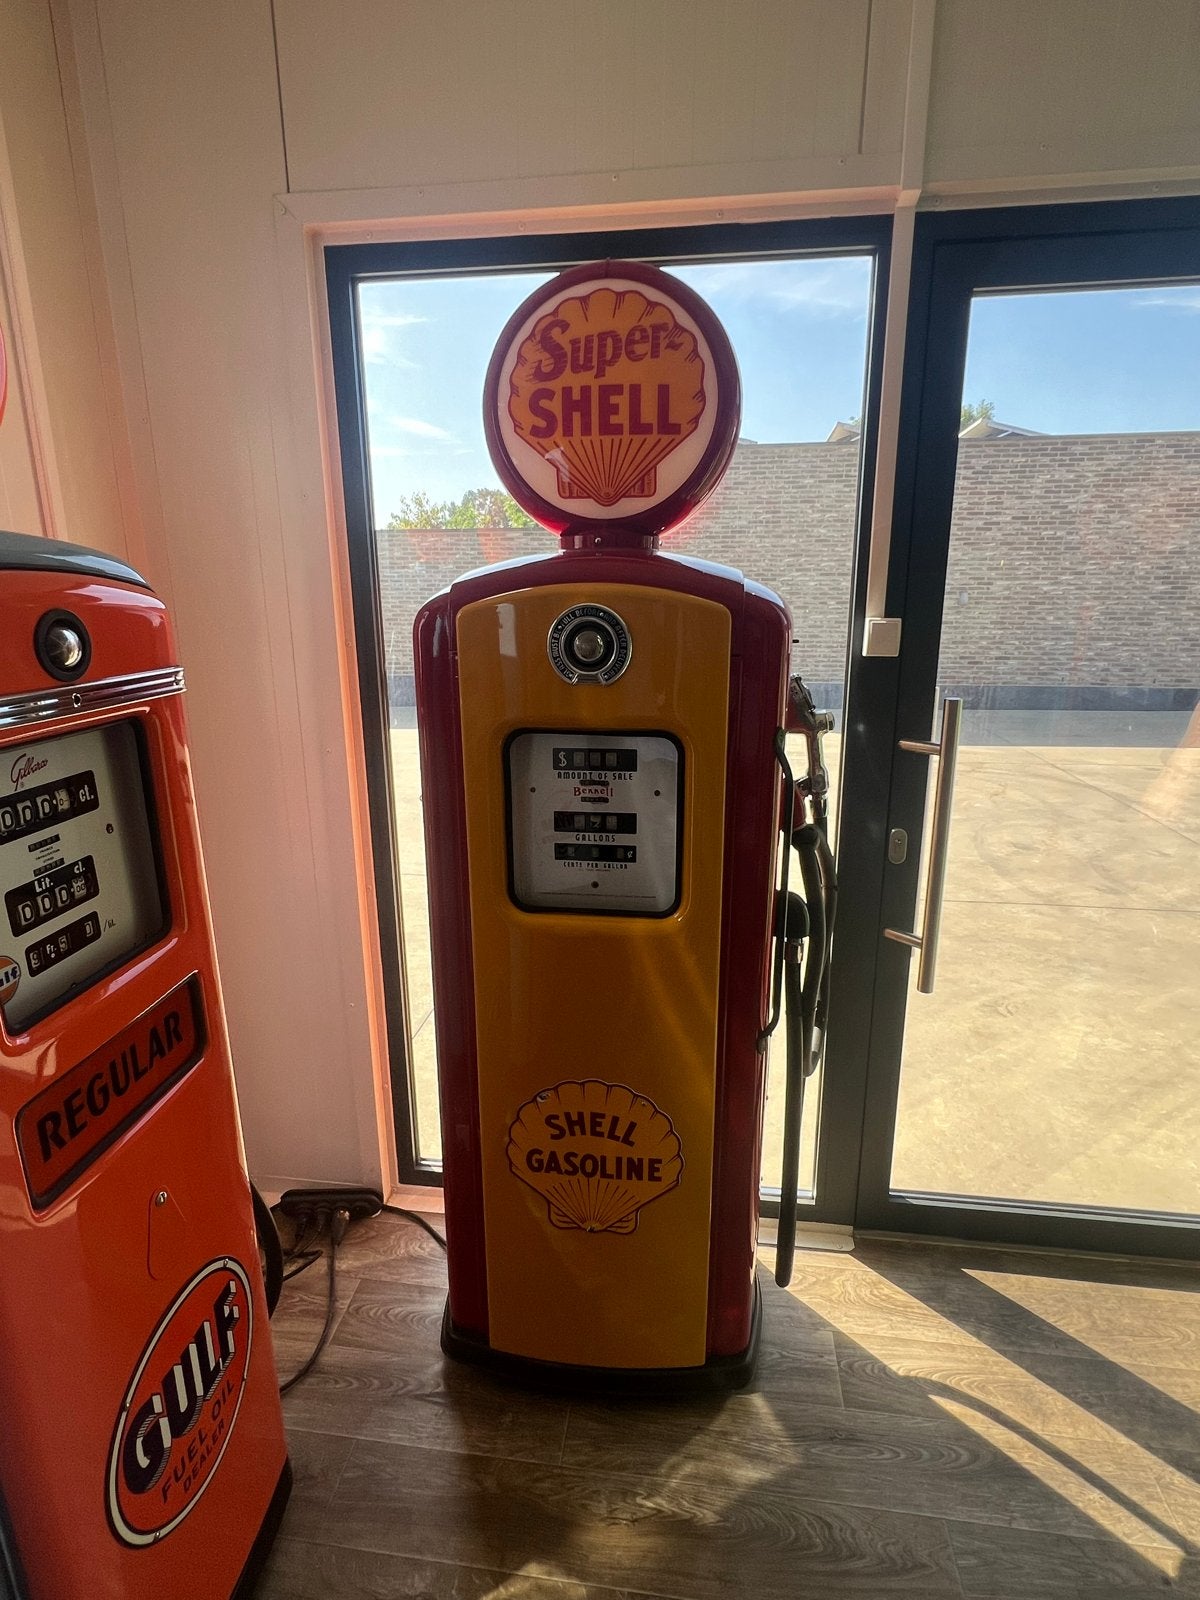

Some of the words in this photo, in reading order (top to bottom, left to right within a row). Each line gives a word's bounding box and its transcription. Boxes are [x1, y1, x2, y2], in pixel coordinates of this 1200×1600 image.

[528, 383, 682, 439] SHELL
[557, 771, 593, 781] AMOUNT
[598, 772, 608, 780] OF
[612, 772, 633, 781] SALE
[558, 751, 567, 767] $
[573, 786, 614, 797] Bennett
[575, 833, 616, 842] GALLONS
[603, 862, 628, 870] GALLON
[36, 1011, 183, 1163] REGULAR
[544, 1111, 637, 1147] SHELL
[525, 1148, 663, 1182] GASOLINE
[122, 1280, 240, 1494] GULF
[161, 1428, 208, 1504] FUEL
[212, 1379, 235, 1421] OIL
[183, 1418, 225, 1493] DEALER
